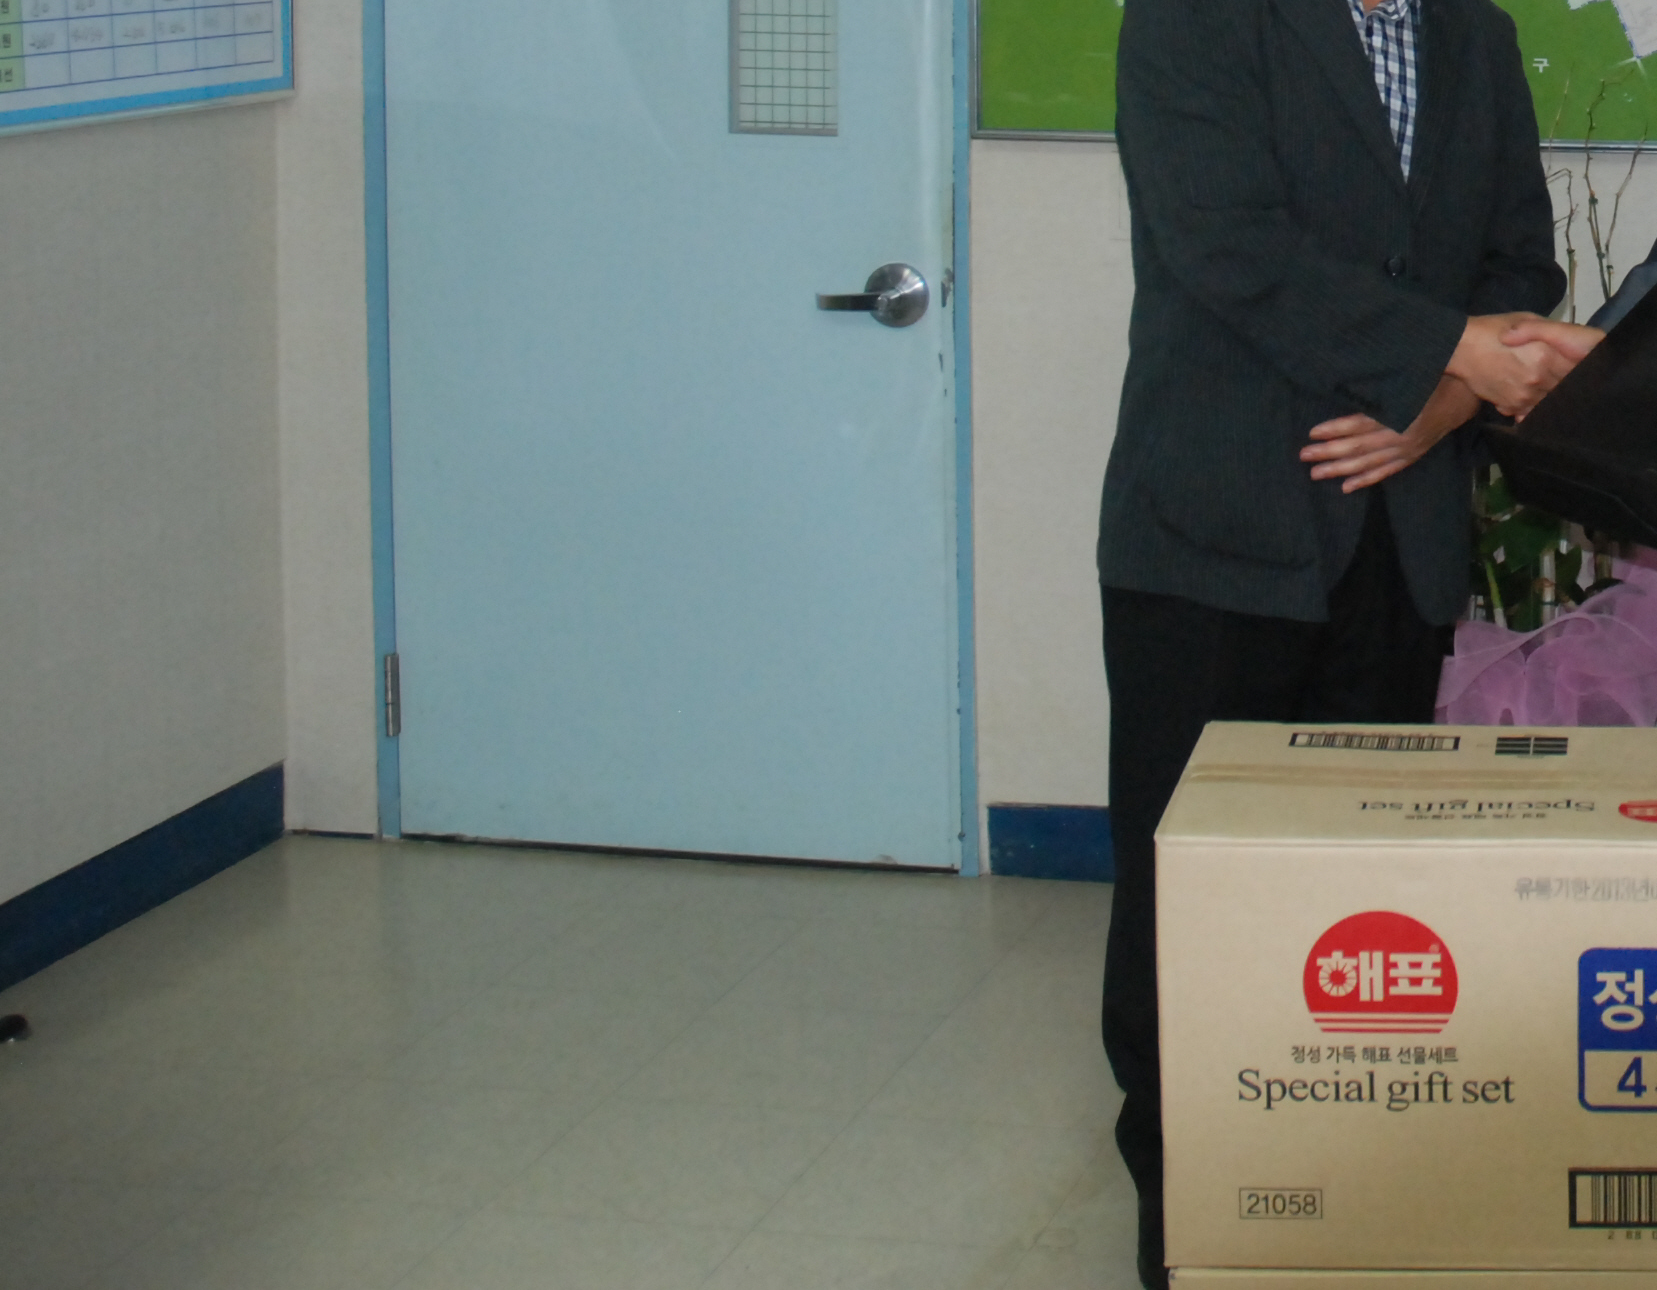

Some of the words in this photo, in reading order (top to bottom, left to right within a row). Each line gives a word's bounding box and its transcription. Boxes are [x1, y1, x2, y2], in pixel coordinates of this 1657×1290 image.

[1359, 798, 1403, 811] set
[1413, 798, 1469, 813] gift
[1478, 798, 1596, 813] Special
[1316, 949, 1443, 1002] 해표
[1291, 1045, 1321, 1064] 정성
[1326, 1046, 1357, 1064] 가득
[1362, 1046, 1393, 1064] 해표
[1396, 1046, 1459, 1065] 선물세트
[1617, 1057, 1647, 1098] 4
[1238, 1068, 1378, 1111] Special
[1386, 1070, 1454, 1112] gift
[1461, 1075, 1516, 1104] set
[1245, 1193, 1318, 1216] 21058
